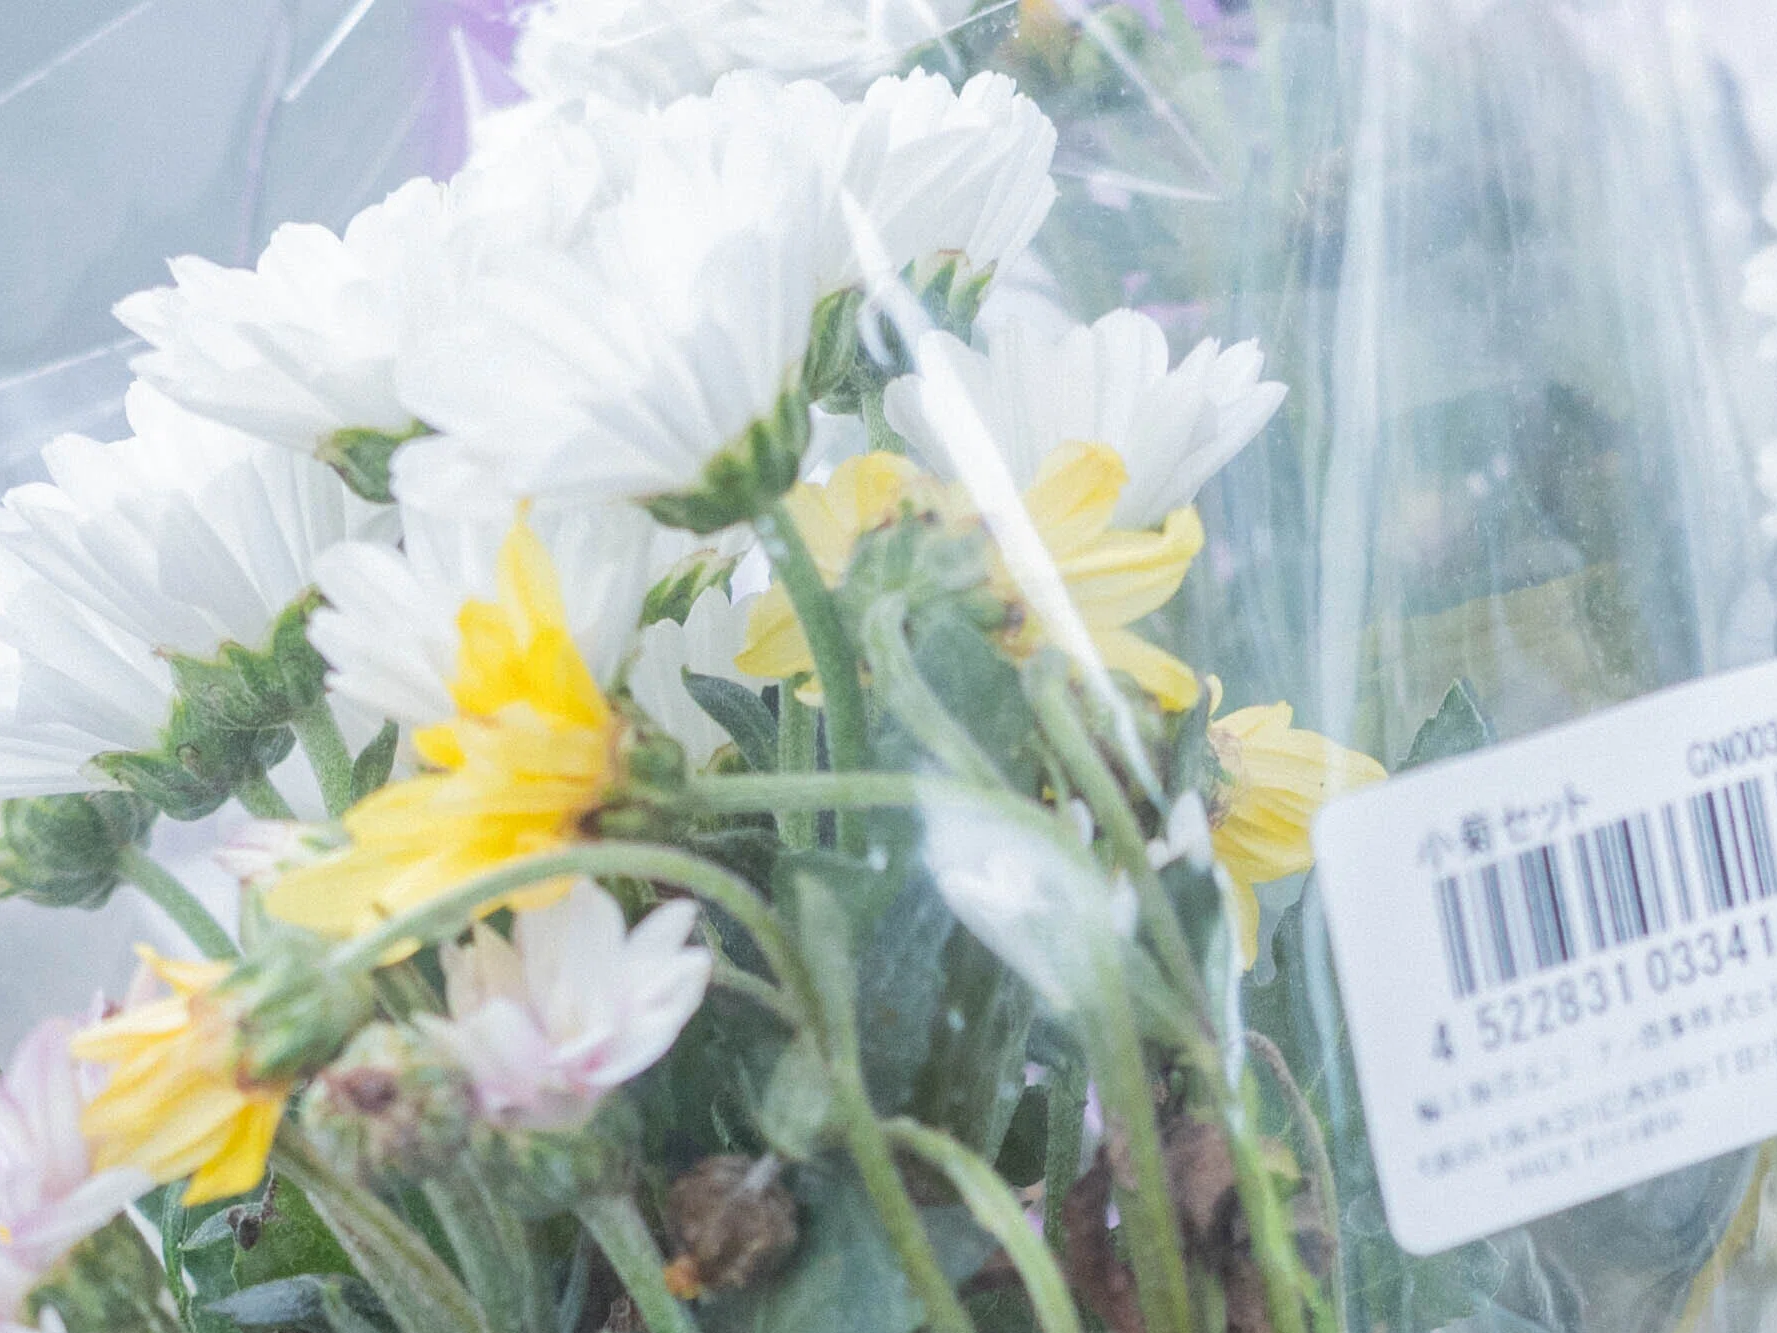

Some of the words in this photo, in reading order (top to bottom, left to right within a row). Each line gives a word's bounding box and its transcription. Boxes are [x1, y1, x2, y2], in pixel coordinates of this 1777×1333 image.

[1418, 783, 1589, 868] 小菊セット
[1430, 1021, 1454, 1061] 4
[1476, 961, 1634, 1051] 522831
